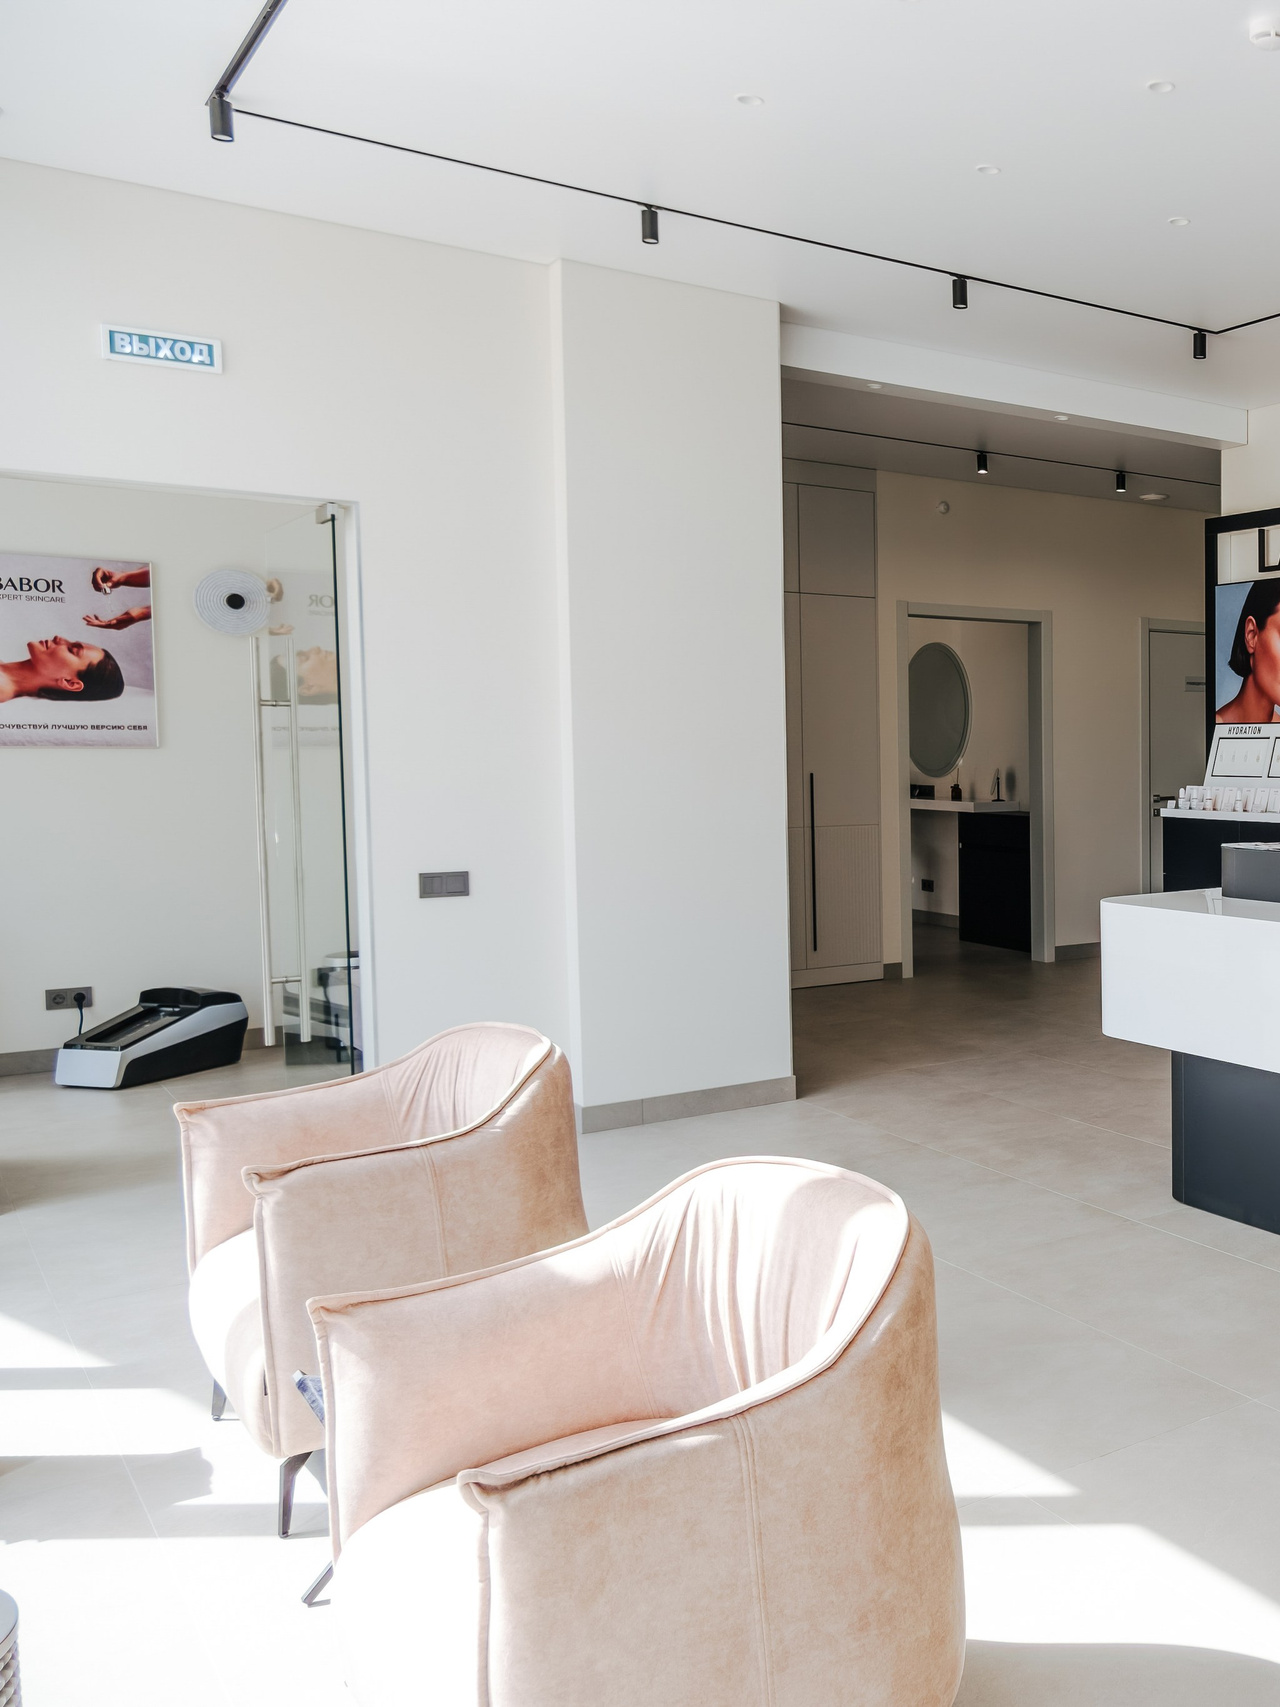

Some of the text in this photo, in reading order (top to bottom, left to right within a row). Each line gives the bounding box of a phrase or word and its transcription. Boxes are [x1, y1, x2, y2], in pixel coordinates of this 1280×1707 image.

[114, 332, 211, 365] ВЫХОД
[25, 595, 66, 603] SKINCARE
[51, 723, 89, 731] ЛУЧШУЮ
[1228, 726, 1262, 735] HYDRATION
